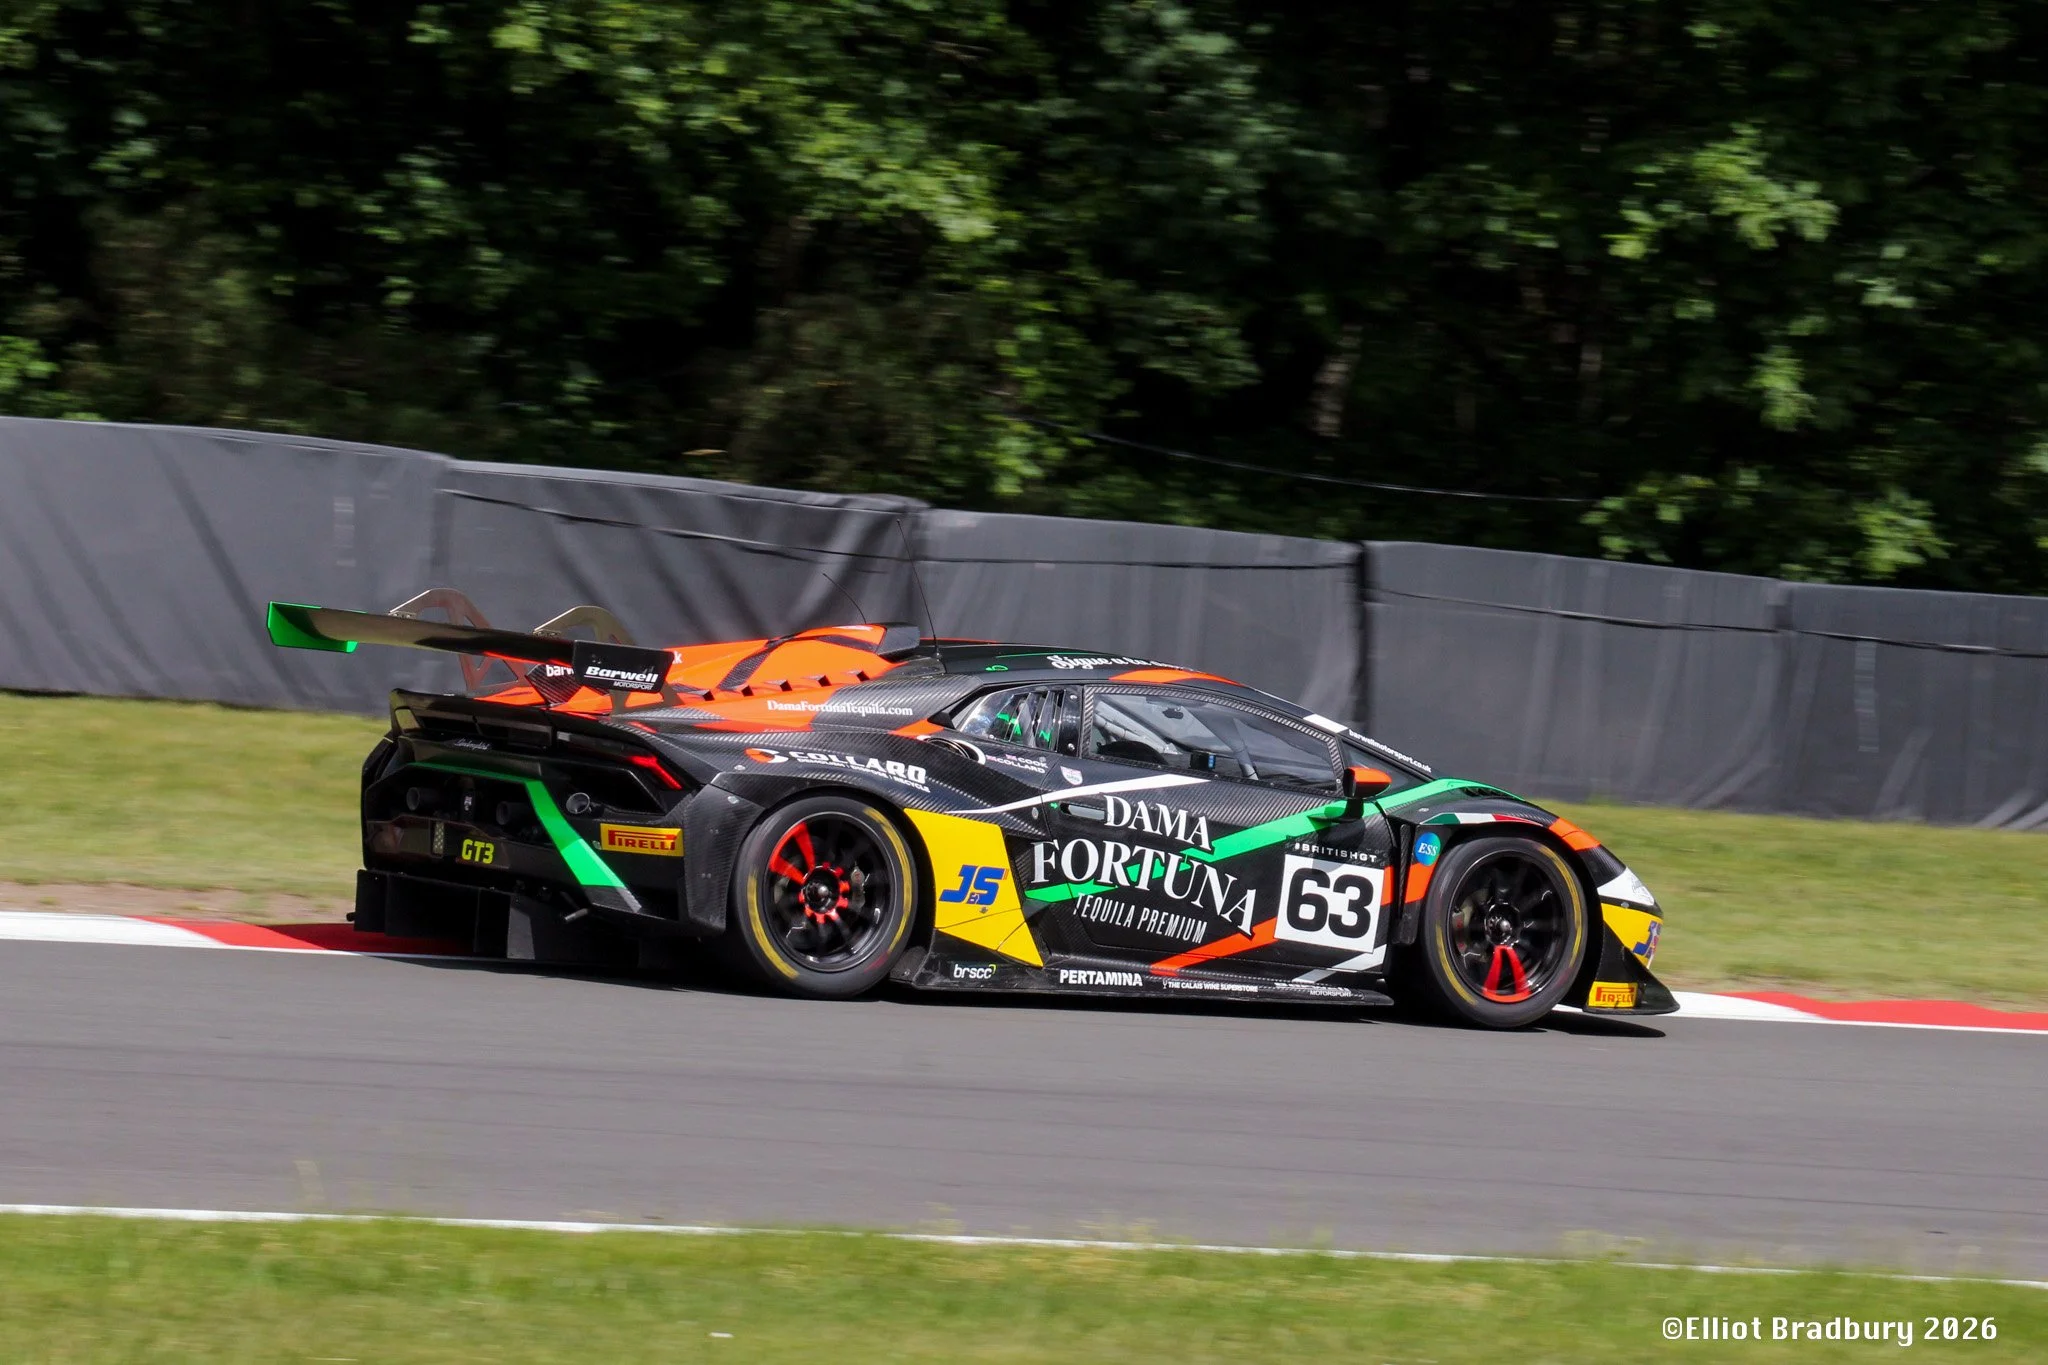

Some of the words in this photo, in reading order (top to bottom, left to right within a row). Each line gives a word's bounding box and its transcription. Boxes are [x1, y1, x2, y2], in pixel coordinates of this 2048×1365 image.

[585, 666, 659, 683] Barwell
[613, 681, 655, 690] MOTORSPORT
[767, 700, 913, 717] DamaFortunaTequila.com
[788, 751, 927, 784] COLLARD
[995, 758, 1046, 774] COLLARD
[1017, 757, 1049, 768] COOK
[1103, 795, 1212, 850] DAMA
[608, 829, 677, 851] PIRELLI
[461, 838, 495, 864] GT3
[1418, 842, 1438, 857] ESS
[939, 864, 1008, 906] JS
[1030, 838, 1257, 936] FORTUNA
[1286, 867, 1374, 939] 63
[1073, 892, 1136, 928] TEQUILA
[1137, 907, 1208, 944] PREMIUM
[953, 963, 996, 979] brscc
[1059, 969, 1143, 987] PERTAMINA
[1168, 981, 1181, 989] THE
[1220, 983, 1258, 993] SUPERSTORE
